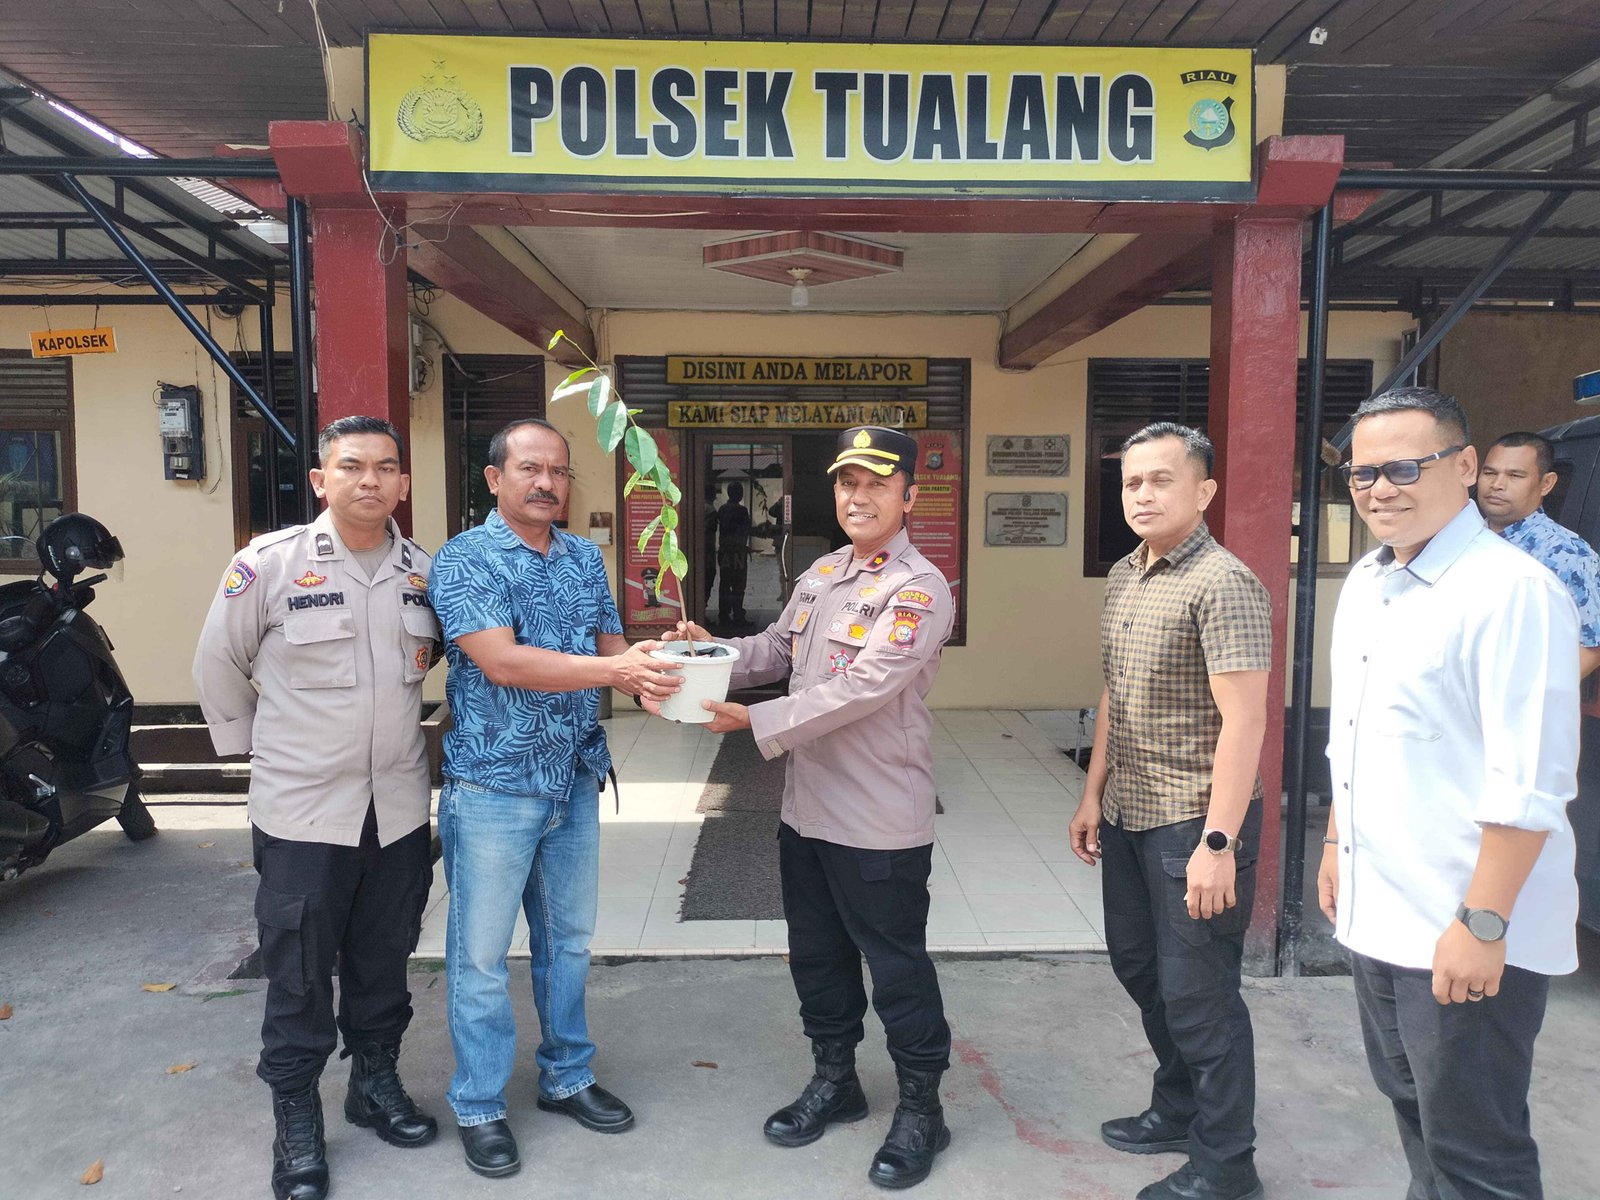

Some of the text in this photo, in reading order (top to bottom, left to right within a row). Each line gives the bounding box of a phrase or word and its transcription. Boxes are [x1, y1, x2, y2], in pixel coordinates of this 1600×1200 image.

[1186, 71, 1230, 82] RIAU
[509, 65, 1154, 162] POLSEK TUALANG
[38, 334, 108, 351] KAPOLSEK
[683, 361, 912, 381] DISINI ANDA MELAPOR
[679, 405, 917, 424] KAMI SIAP MELAYANI ANDA
[287, 592, 345, 611] HENDRI
[402, 593, 430, 607] POL
[841, 601, 875, 618] POLRI
[897, 611, 918, 620] RIAU
